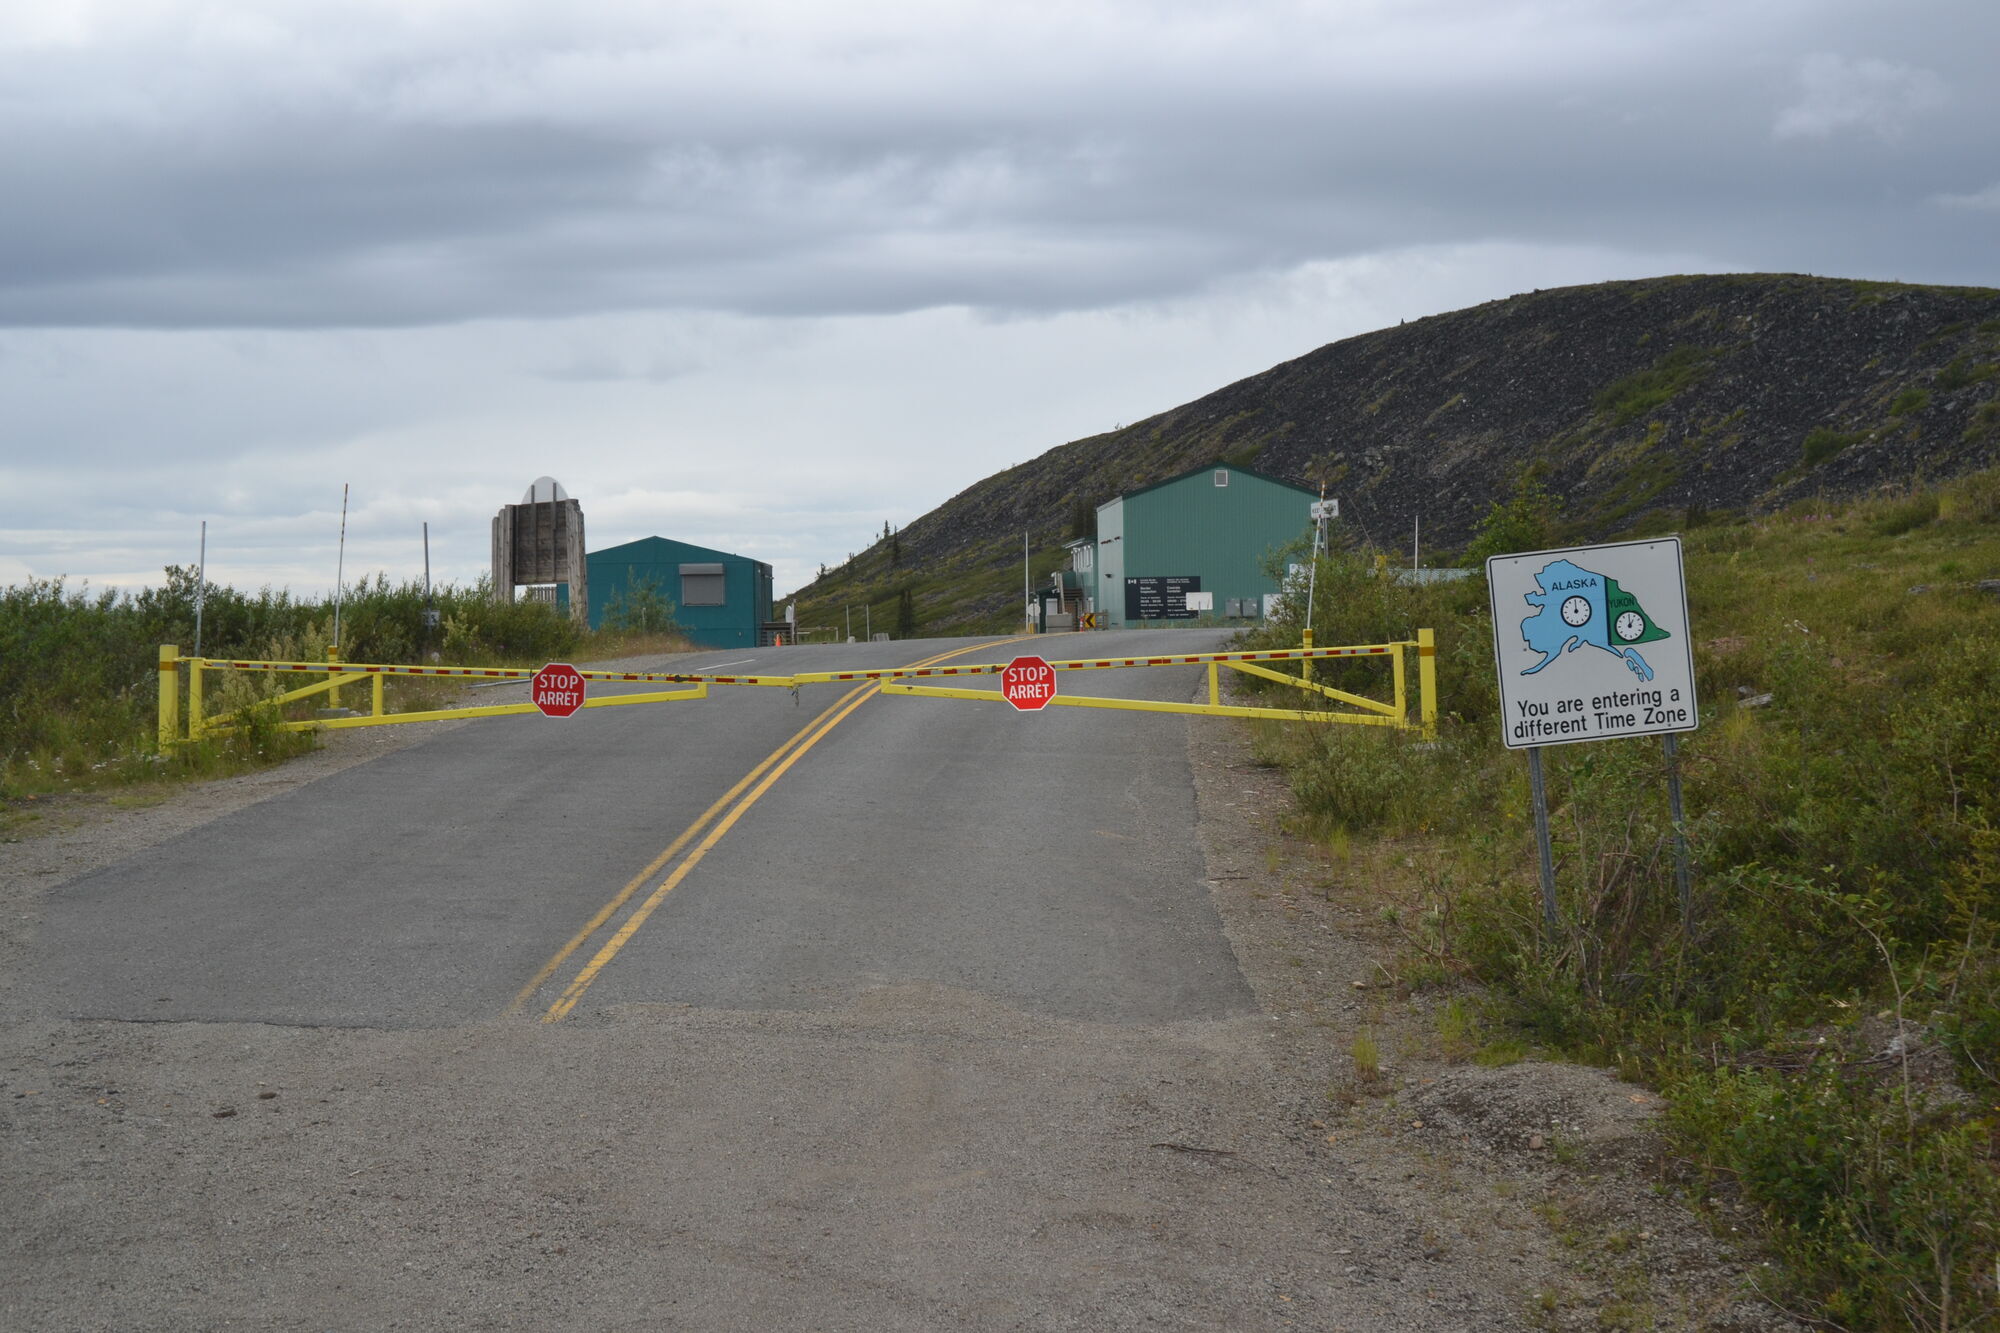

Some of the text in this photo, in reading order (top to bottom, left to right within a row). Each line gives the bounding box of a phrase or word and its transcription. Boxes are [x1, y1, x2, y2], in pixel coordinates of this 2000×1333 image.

[1551, 578, 1598, 591] ALASKA
[1609, 596, 1635, 609] YUKON
[539, 673, 579, 689] STOP
[1008, 666, 1048, 682] STOP
[1517, 688, 1680, 717] You are entering a
[1514, 707, 1687, 739] different Time Zone
